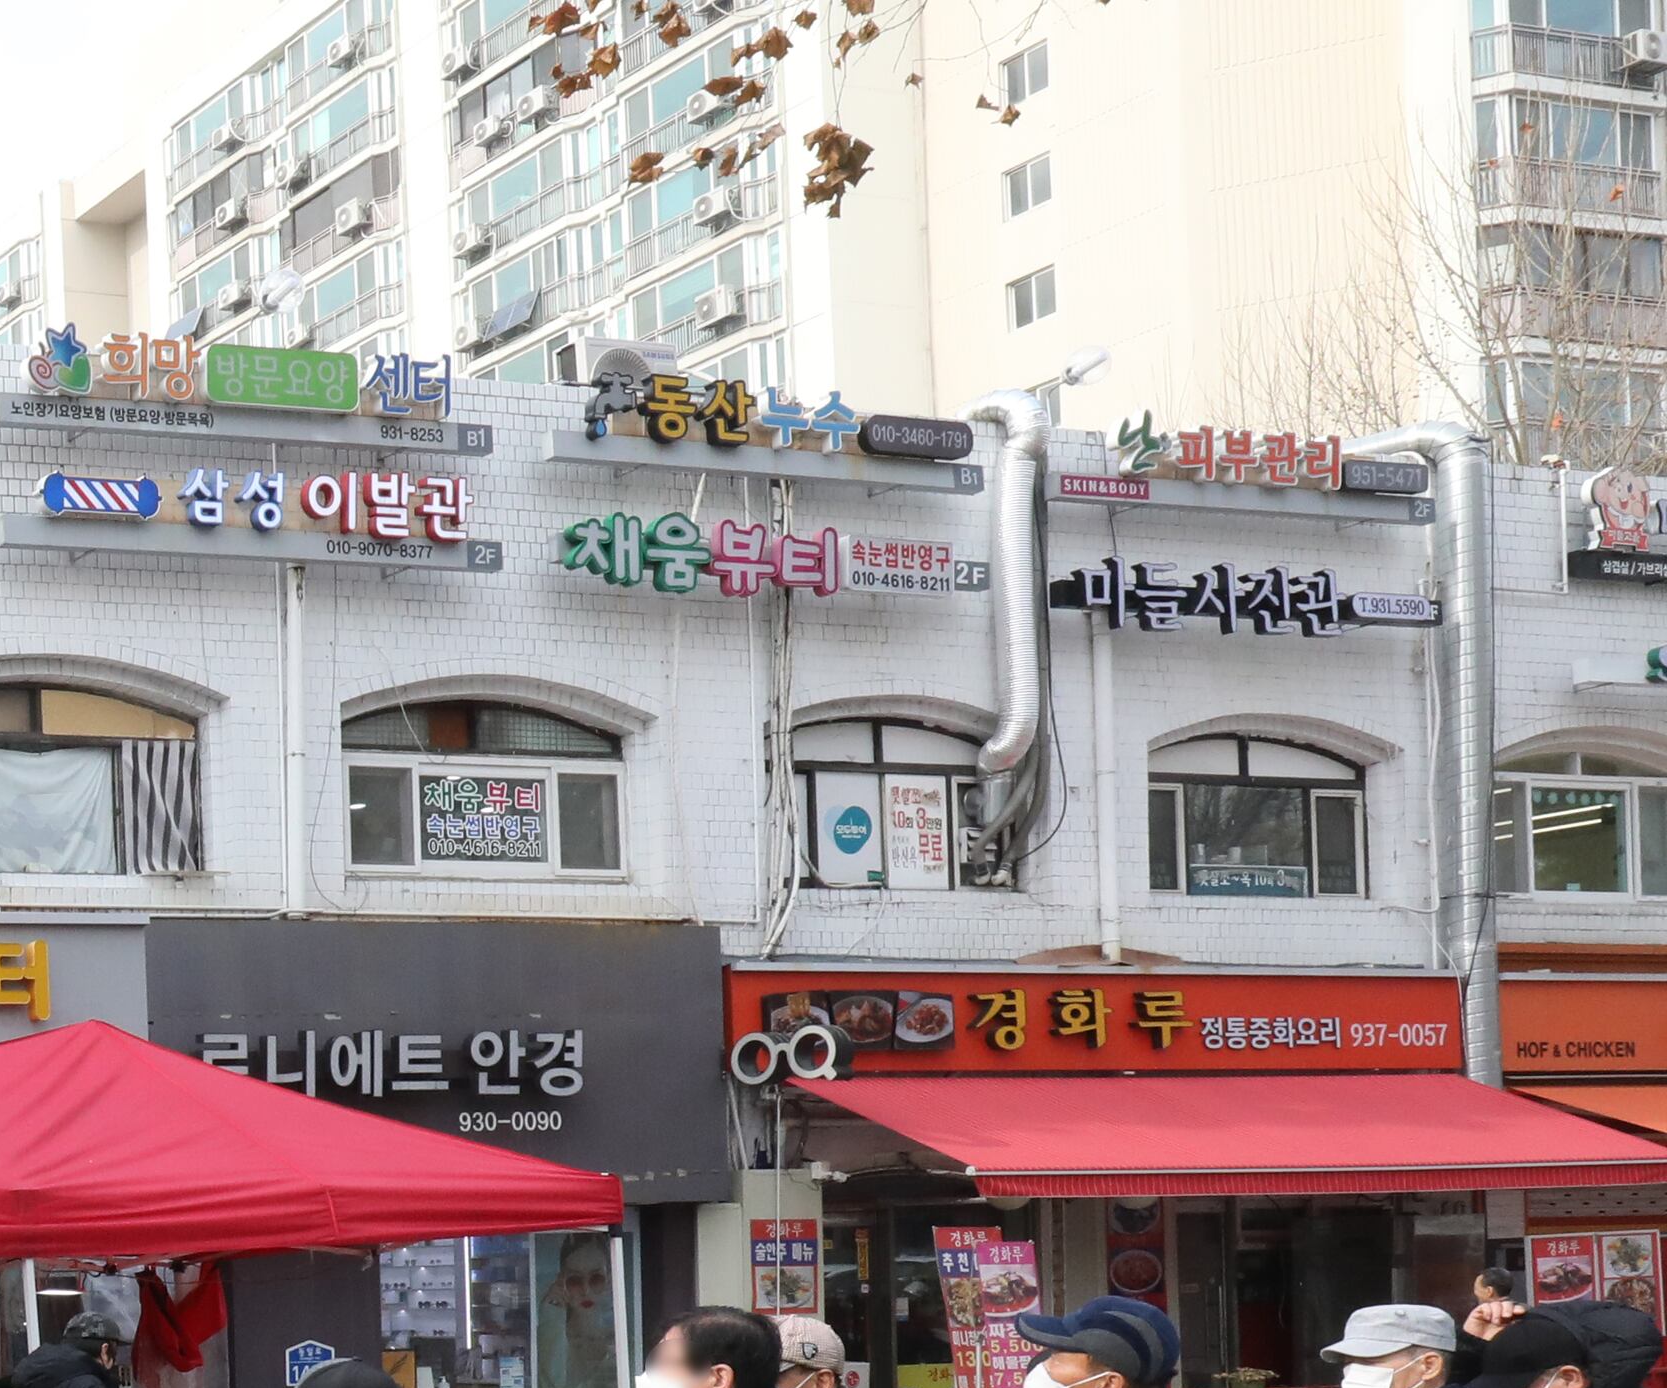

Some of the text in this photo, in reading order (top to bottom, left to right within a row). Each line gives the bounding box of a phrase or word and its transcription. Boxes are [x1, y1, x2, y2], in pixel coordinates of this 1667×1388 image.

[102, 332, 452, 416] 희망 방문요양 센터
[11, 402, 105, 422] 노인장기요양보험
[642, 375, 860, 452] 동산 누수
[381, 426, 443, 443] 931-8253
[467, 431, 486, 447] B1
[872, 424, 967, 449] 010-3460-1791
[1176, 425, 1341, 489] 피부관리
[961, 467, 978, 485] B1
[1352, 465, 1422, 488] 951-5471
[1064, 478, 1147, 497] SKIN&BODY
[180, 468, 473, 542] 삼성 이발관
[1414, 502, 1431, 518] 2F
[327, 540, 432, 559] 010-9070-8377
[475, 545, 496, 564] 2F
[566, 512, 839, 596] 채움뷰티
[852, 541, 951, 572] 속눈썹반영구
[956, 563, 985, 585] 2F
[1603, 560, 1629, 574] 삼겹살
[852, 571, 951, 591] 010-4616-8211
[1073, 555, 1345, 636] 마들사진관
[424, 779, 541, 813] 채움뷰티
[427, 814, 541, 839] 속눈썹반영구
[427, 839, 541, 859] 010-4616-8211
[919, 834, 943, 862] 무료
[970, 988, 1448, 1051] 경화루 정통중화요리 937-0057
[1516, 1042, 1635, 1058] HOF & CHICKEN
[470, 1029, 584, 1096] 안경
[459, 1112, 561, 1132] 930-0090
[989, 1246, 1024, 1264] 경화루
